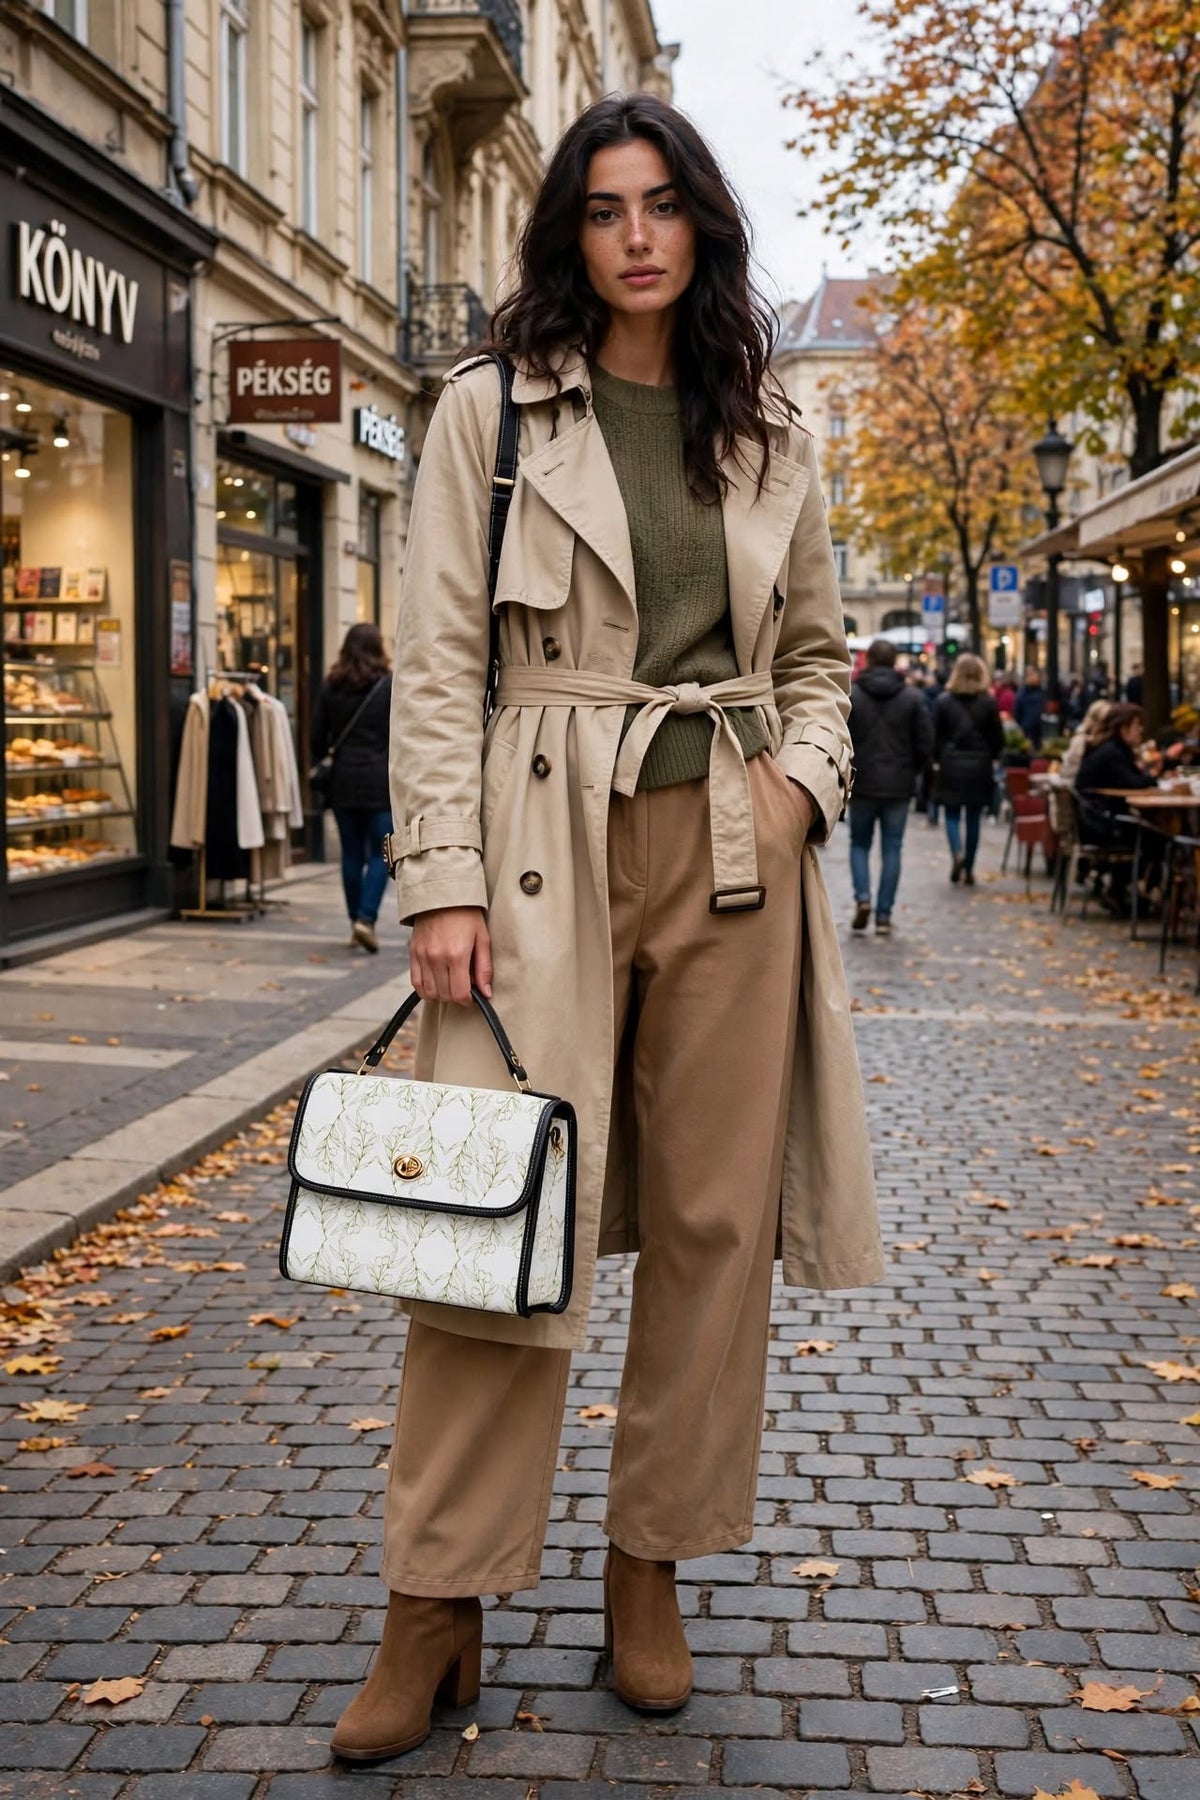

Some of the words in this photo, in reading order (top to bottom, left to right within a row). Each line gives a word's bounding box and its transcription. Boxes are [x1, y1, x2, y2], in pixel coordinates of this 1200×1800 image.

[19, 219, 138, 344] KÖNYV
[237, 358, 331, 396] PÉKSÉG
[998, 569, 1012, 591] P
